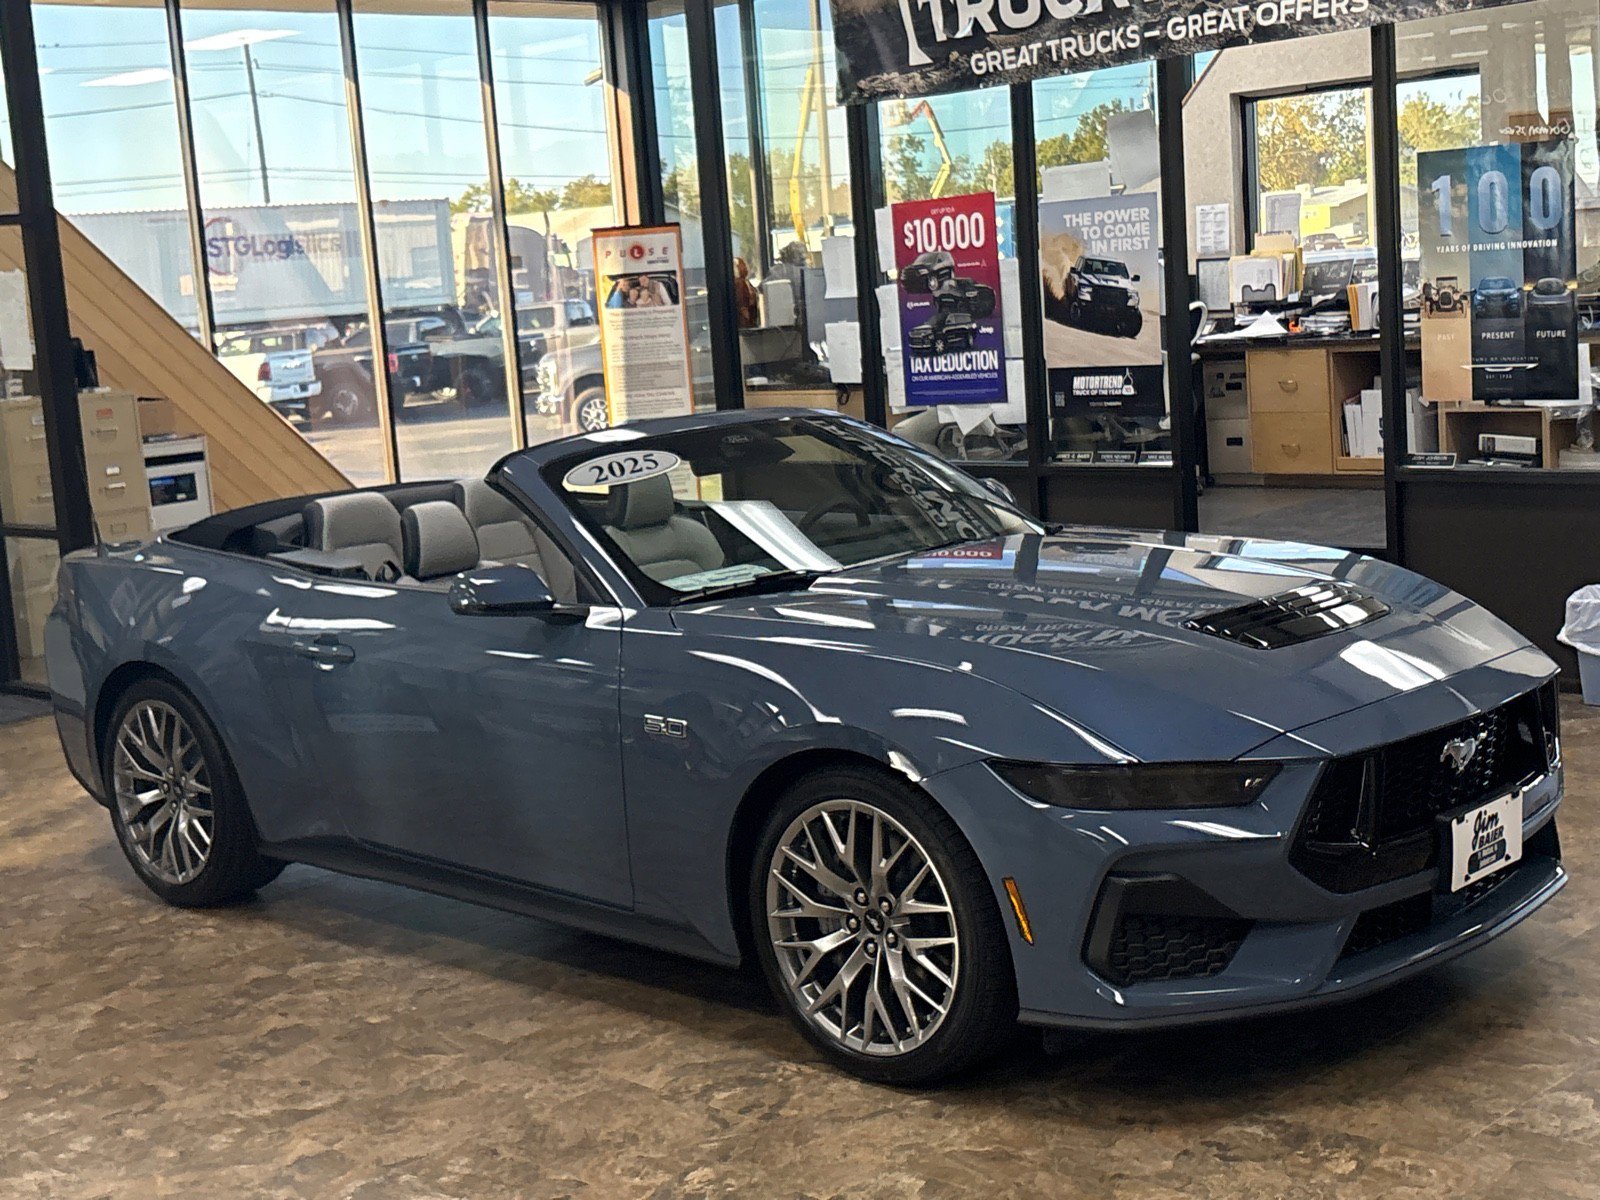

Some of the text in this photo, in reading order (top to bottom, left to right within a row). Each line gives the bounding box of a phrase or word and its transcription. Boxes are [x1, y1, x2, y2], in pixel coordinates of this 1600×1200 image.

[970, 43, 1041, 76] GREAT
[1044, 26, 1141, 62] TRUCKS
[1166, 5, 1249, 41] GREAT
[1255, 0, 1370, 28] OFFERS
[1431, 164, 1563, 236] 100
[1063, 207, 1150, 228] THE POWER
[903, 211, 985, 254] $10,000
[1081, 221, 1151, 240] TO COME
[604, 244, 669, 260] PULSE
[1091, 236, 1151, 254] IN FIRST
[1436, 238, 1558, 253] YEARS OF DRIVING INNOVATION
[1481, 331, 1515, 340] PRESENT
[1536, 330, 1567, 339] FUTURE
[933, 350, 999, 373] DEDUCTION
[1073, 375, 1123, 390] MOTORTREND
[588, 453, 660, 484] 2025
[1471, 809, 1500, 851] Jim
